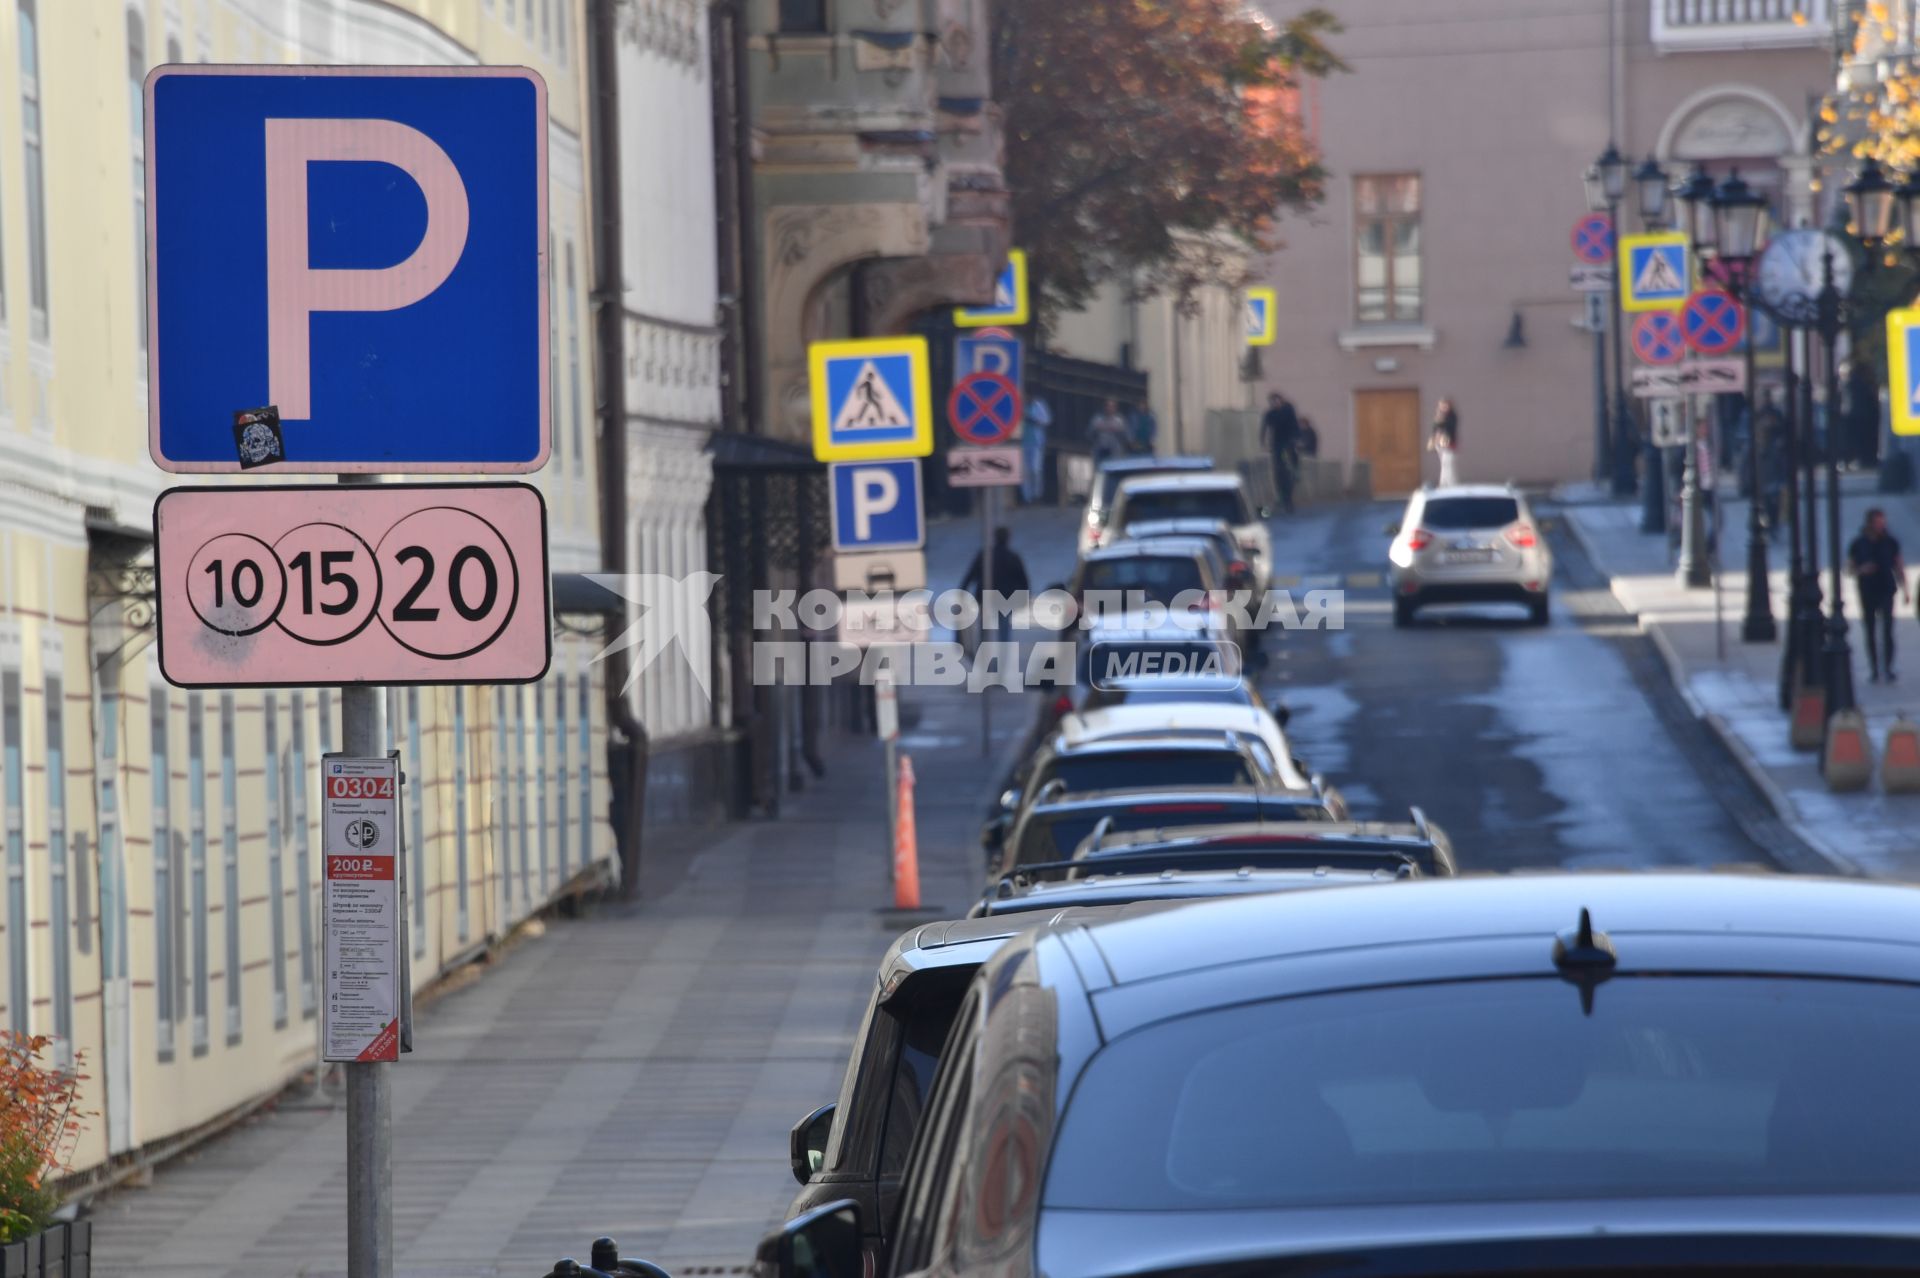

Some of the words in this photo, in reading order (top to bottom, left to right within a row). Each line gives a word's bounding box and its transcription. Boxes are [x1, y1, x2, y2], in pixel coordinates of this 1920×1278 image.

[265, 118, 470, 421] P
[852, 468, 899, 541] P
[204, 558, 264, 609] 10
[288, 550, 359, 617] 15
[392, 545, 498, 623] 20
[333, 778, 393, 797] 0304
